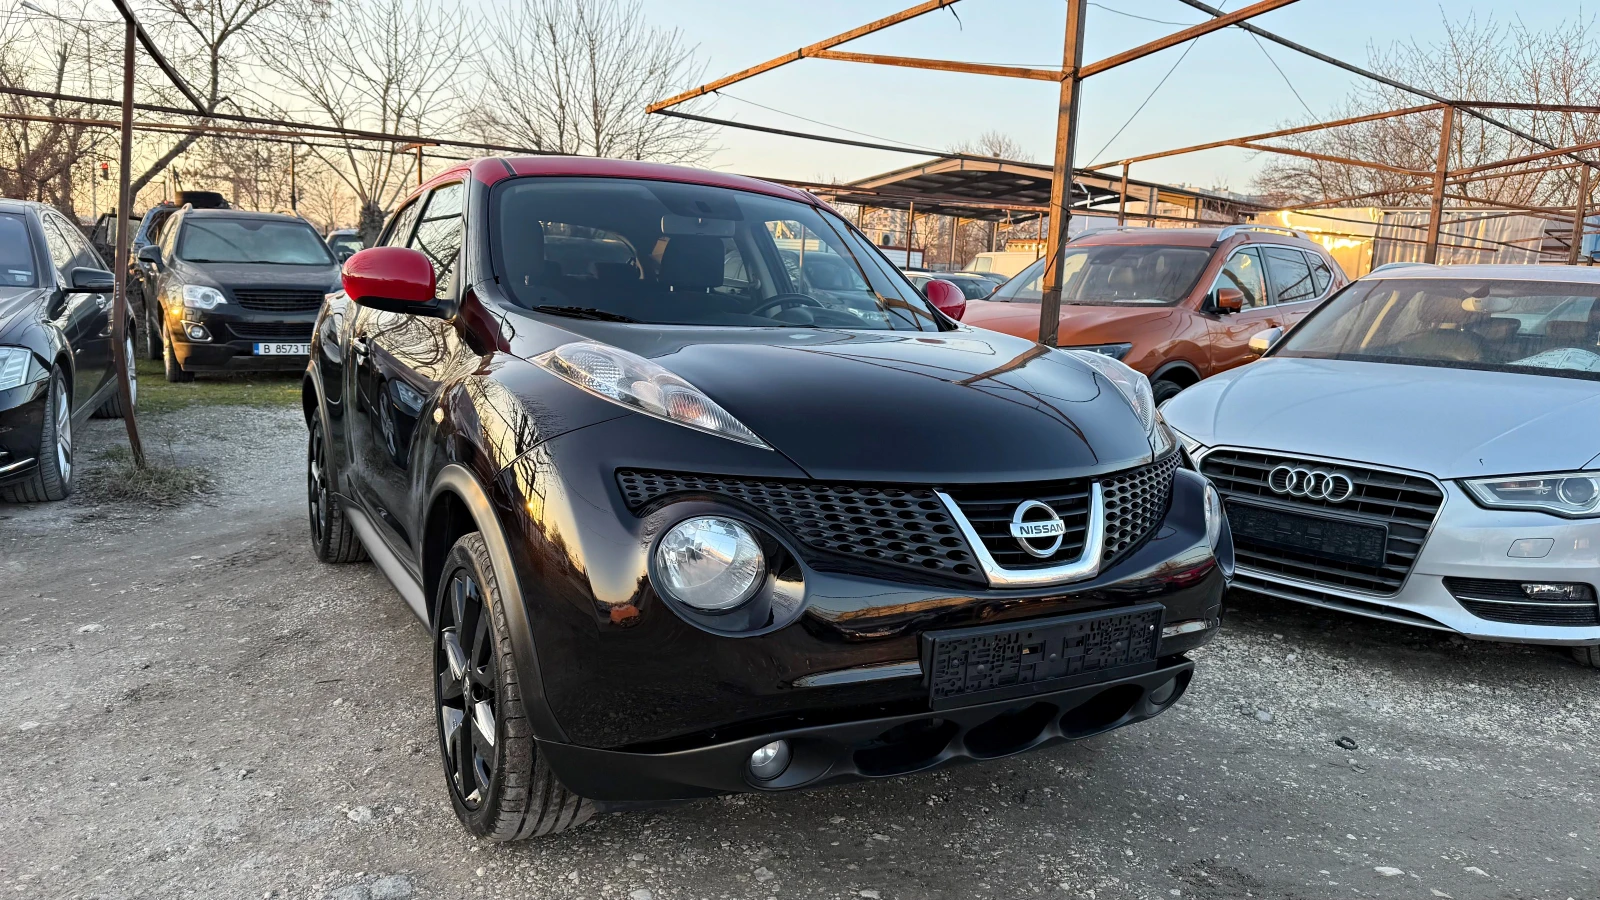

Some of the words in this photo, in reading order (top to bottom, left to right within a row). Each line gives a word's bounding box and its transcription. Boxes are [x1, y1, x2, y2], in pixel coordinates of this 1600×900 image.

[263, 344, 271, 354] B
[275, 344, 299, 354] 8573
[1019, 523, 1064, 535] NISSAN
